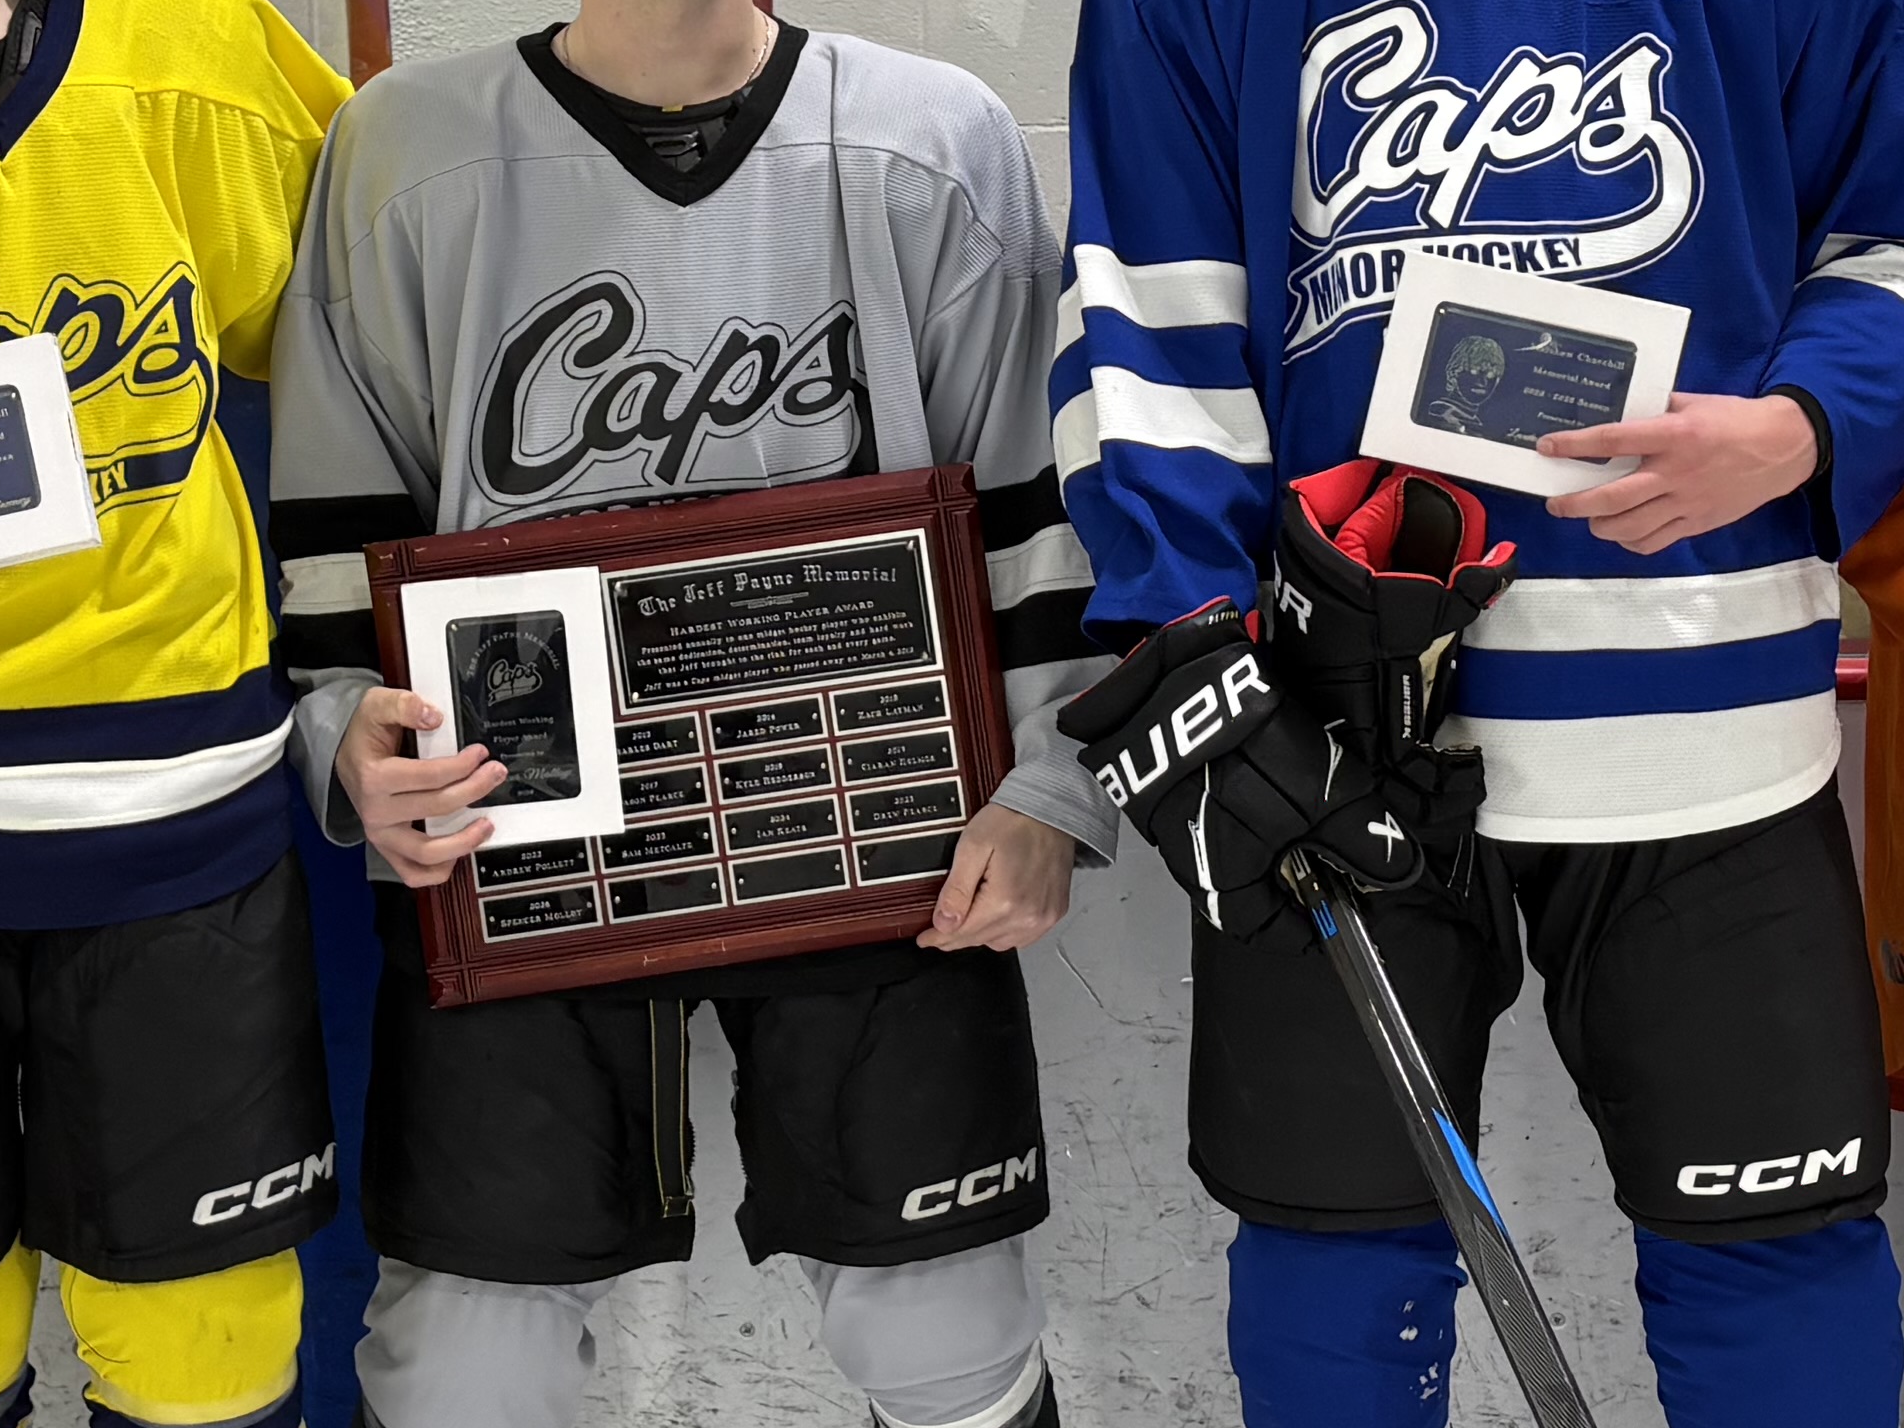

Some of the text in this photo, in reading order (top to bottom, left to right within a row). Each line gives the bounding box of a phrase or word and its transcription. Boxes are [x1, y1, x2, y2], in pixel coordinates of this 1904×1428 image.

[470, 270, 878, 504] Caps
[637, 595, 676, 616] The
[733, 571, 794, 592] Payne
[802, 564, 897, 583] Memorial
[670, 600, 874, 636] HARDEST WORKING PLAYER AWARD
[1096, 653, 1271, 808] AUER
[192, 1141, 336, 1226] CCM
[901, 1147, 1037, 1221] CCM
[1677, 1137, 1861, 1195] CCM
